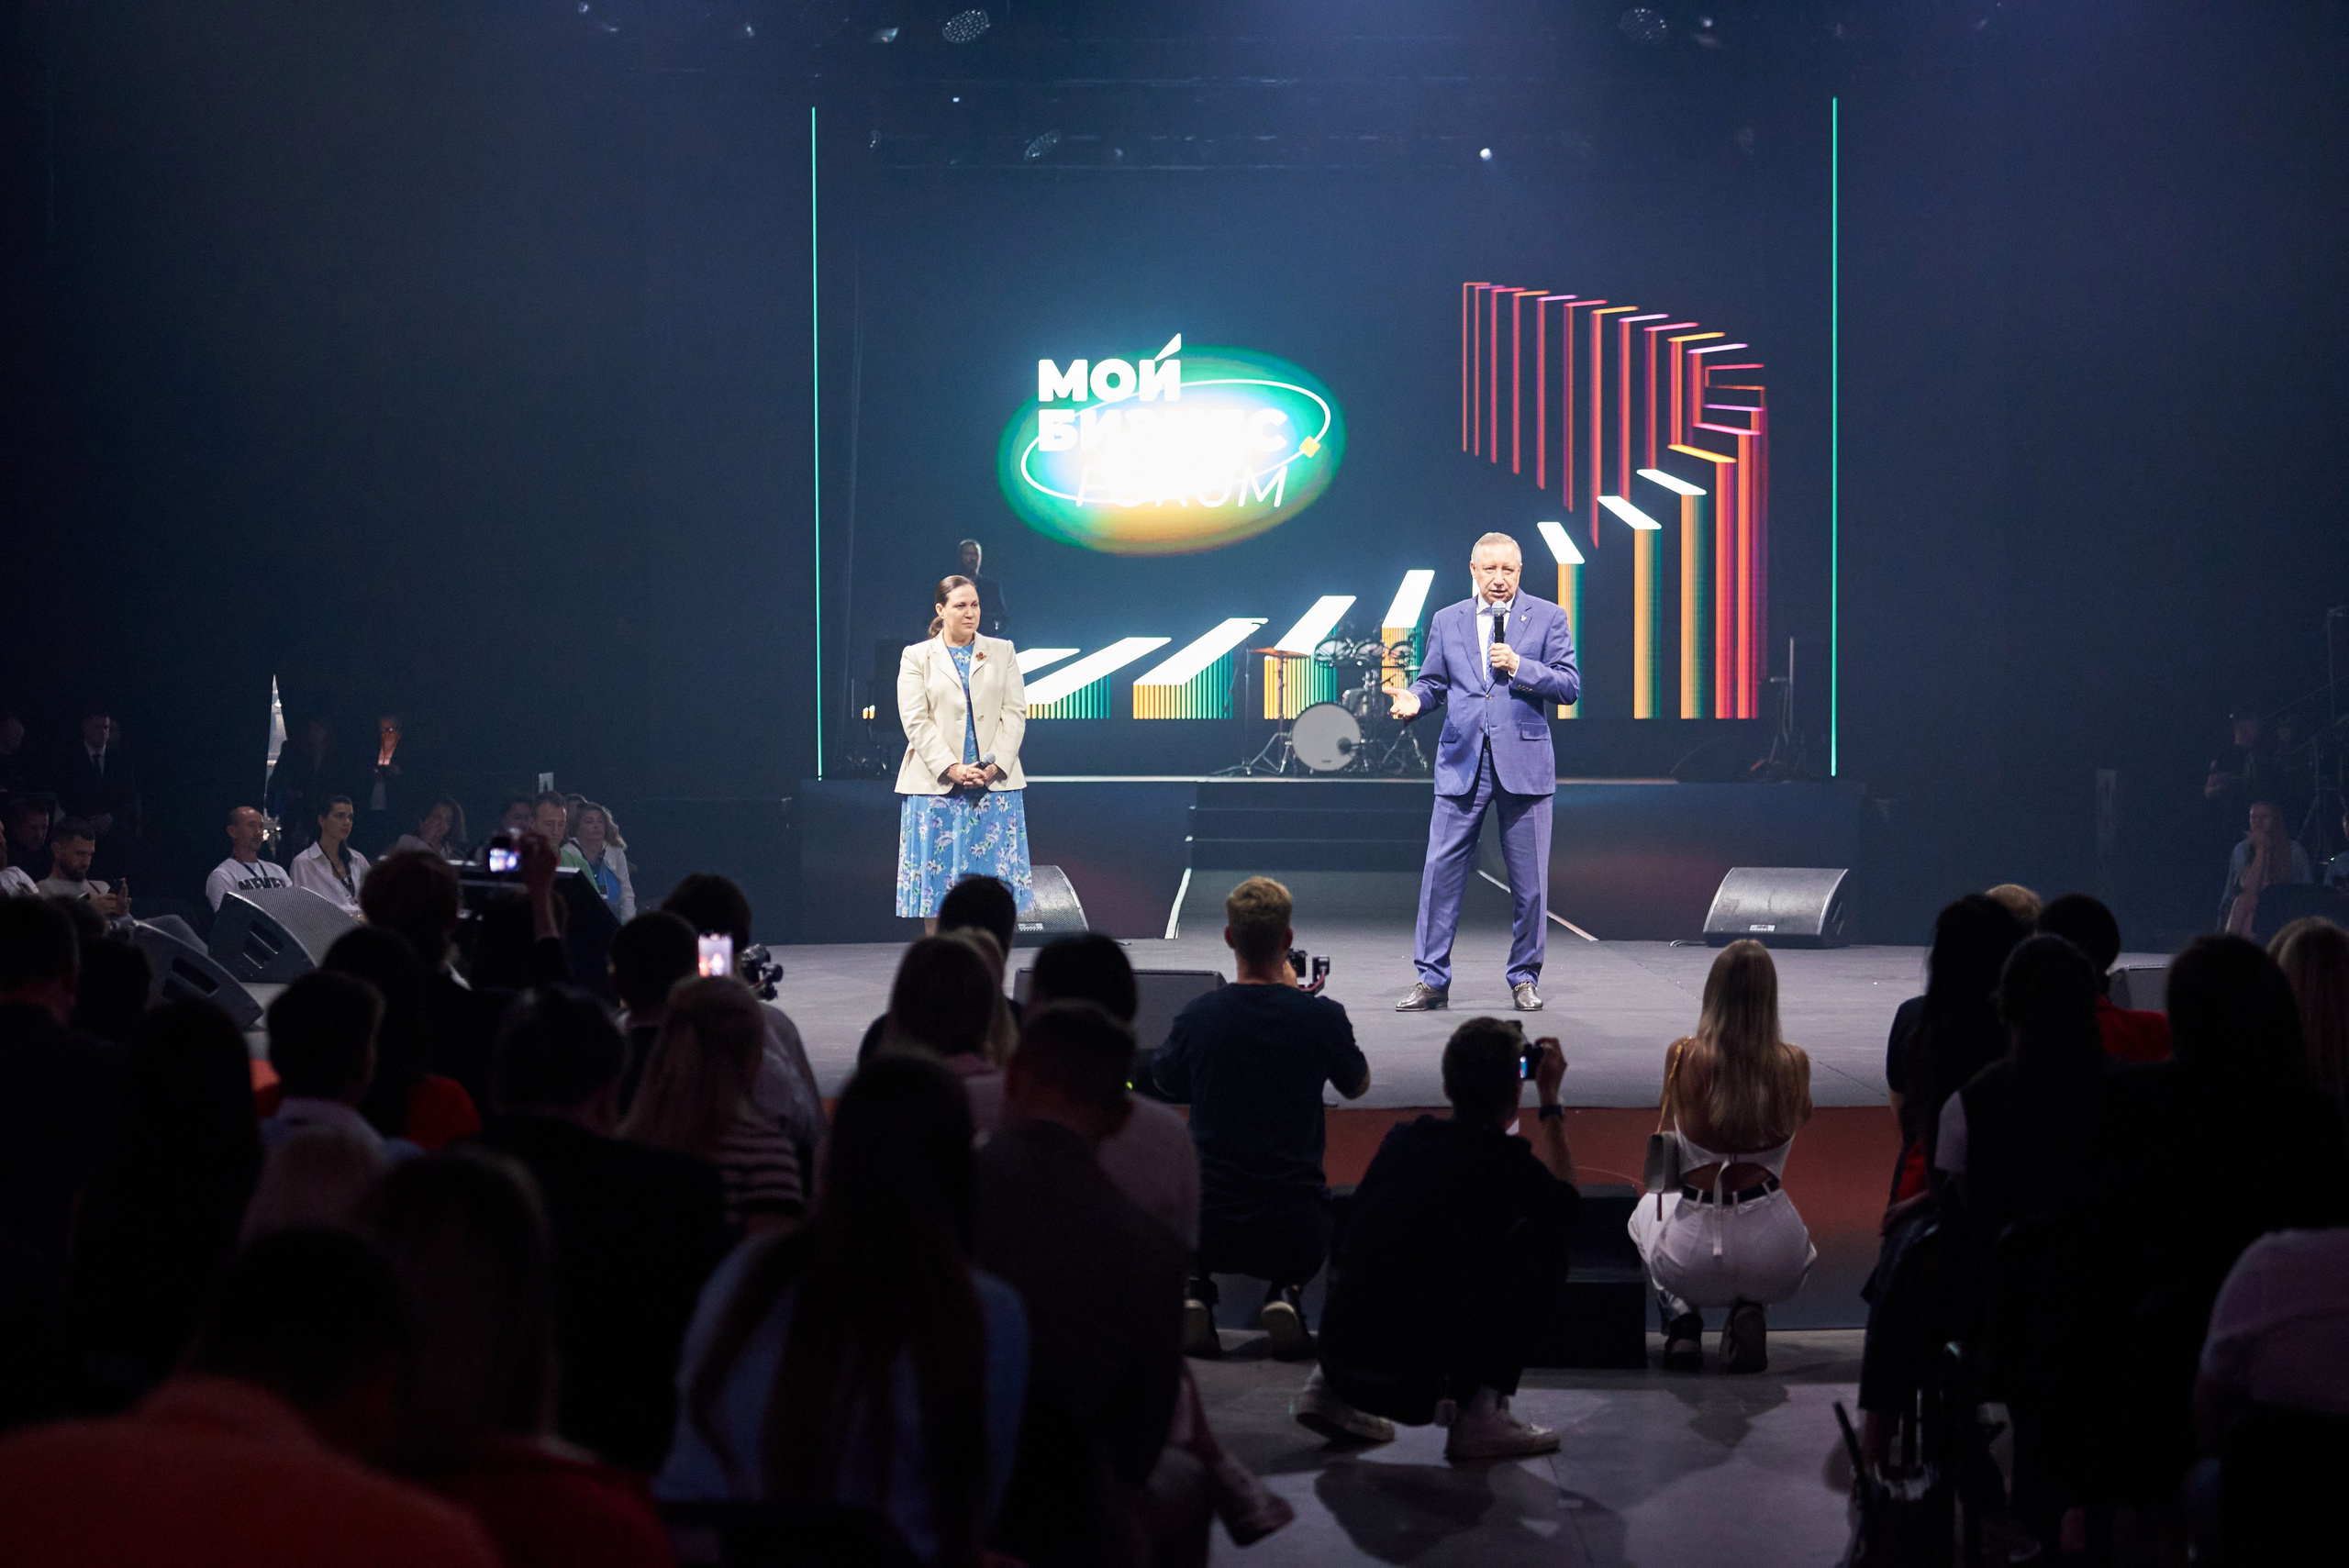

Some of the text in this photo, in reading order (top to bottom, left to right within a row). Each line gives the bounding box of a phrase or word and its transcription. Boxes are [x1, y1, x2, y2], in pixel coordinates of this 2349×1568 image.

[1038, 332, 1182, 402] МОЙ
[1038, 408, 1288, 451] БИС
[1075, 465, 1288, 508] FUM
